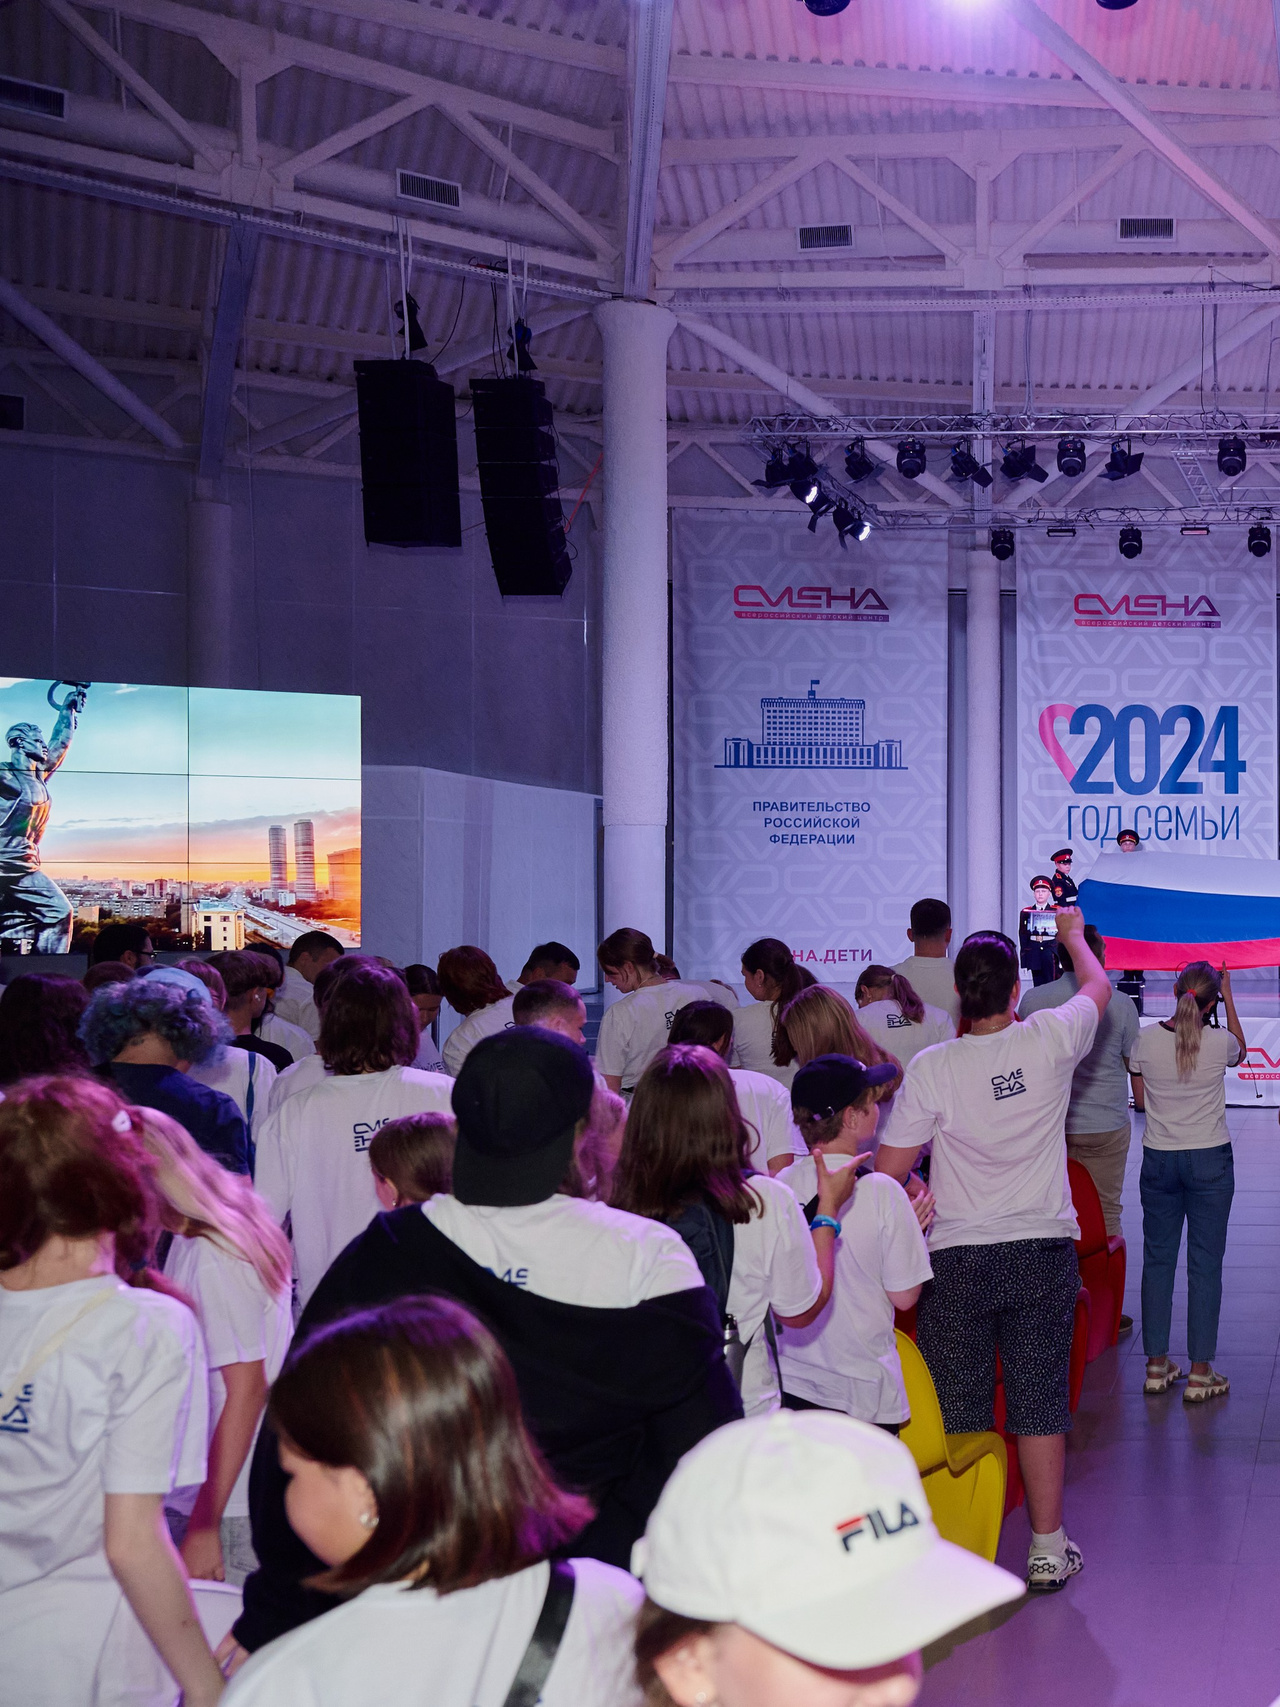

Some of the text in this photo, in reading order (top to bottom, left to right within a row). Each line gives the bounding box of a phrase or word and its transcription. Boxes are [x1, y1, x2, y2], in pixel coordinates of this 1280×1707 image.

[741, 611, 885, 622] всероссийский детский центр
[1081, 619, 1149, 628] всероссийский
[1152, 620, 1187, 628] детский
[1068, 703, 1247, 796] 2024
[752, 801, 871, 812] ПРАВИТЕЛЬСТВО
[763, 815, 860, 828] РОССИЙСКОЙ
[769, 833, 855, 846] ФЕДЕРАЦИИ
[792, 948, 872, 964] НА.ДЕТИ
[836, 1502, 919, 1552] FILA
